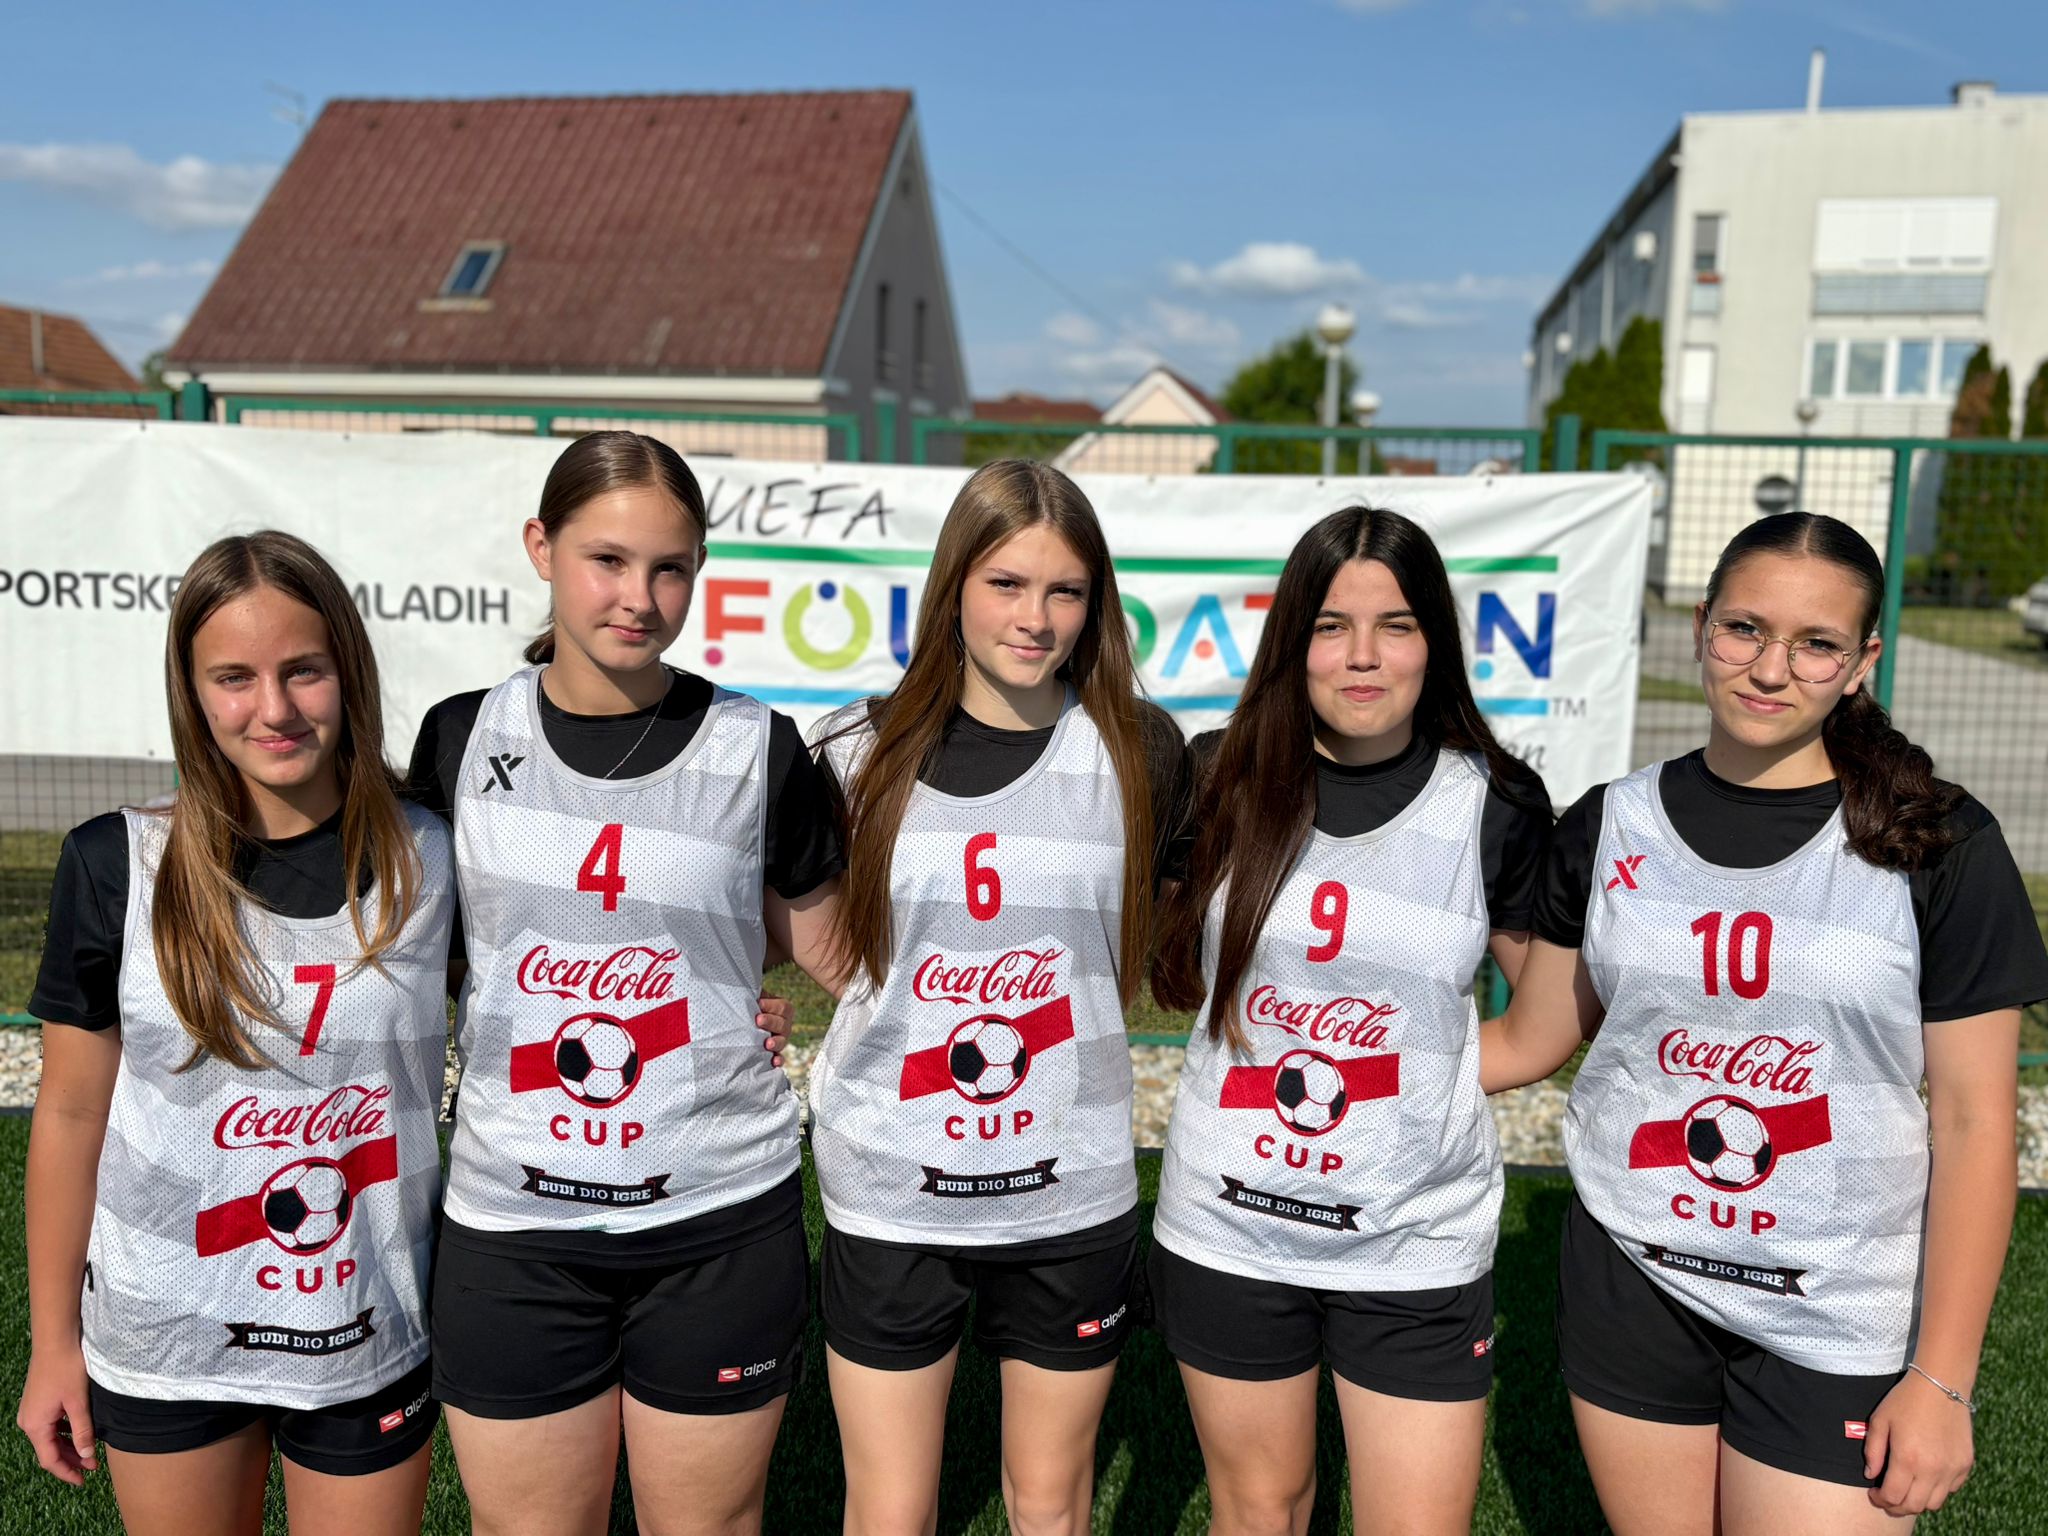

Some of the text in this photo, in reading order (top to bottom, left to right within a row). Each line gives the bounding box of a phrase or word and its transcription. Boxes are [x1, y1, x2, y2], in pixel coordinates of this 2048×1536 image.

[706, 478, 894, 538] UEFA
[1552, 698, 1587, 718] TM
[577, 824, 626, 912] 4
[964, 832, 1001, 921] 6
[1306, 880, 1348, 962] 9
[517, 944, 682, 1001] Coca-Cola
[1691, 911, 1773, 1000] 10
[913, 948, 1066, 1006] Coca-Cola
[294, 964, 336, 1057] 7
[1247, 985, 1401, 1049] Coca-Cola
[1658, 1029, 1825, 1094] Coca-Cola
[213, 1084, 393, 1150] Coca-Cola
[550, 1114, 645, 1149] CUP
[945, 1109, 1034, 1140] CUP
[1254, 1134, 1343, 1175] CUP
[538, 1180, 652, 1201] BUDI DIO IGRE
[937, 1172, 1042, 1192] BUDI DIO IGRE
[1236, 1190, 1341, 1224] BUDI DIO IGRE
[1671, 1193, 1777, 1235] CUP
[256, 1258, 356, 1294] CUP
[1662, 1251, 1785, 1287] BUDI DIO IGRE
[1101, 1304, 1126, 1328] alpas
[248, 1326, 363, 1349] BUDI DIO IGRE
[743, 1359, 777, 1376] alpas
